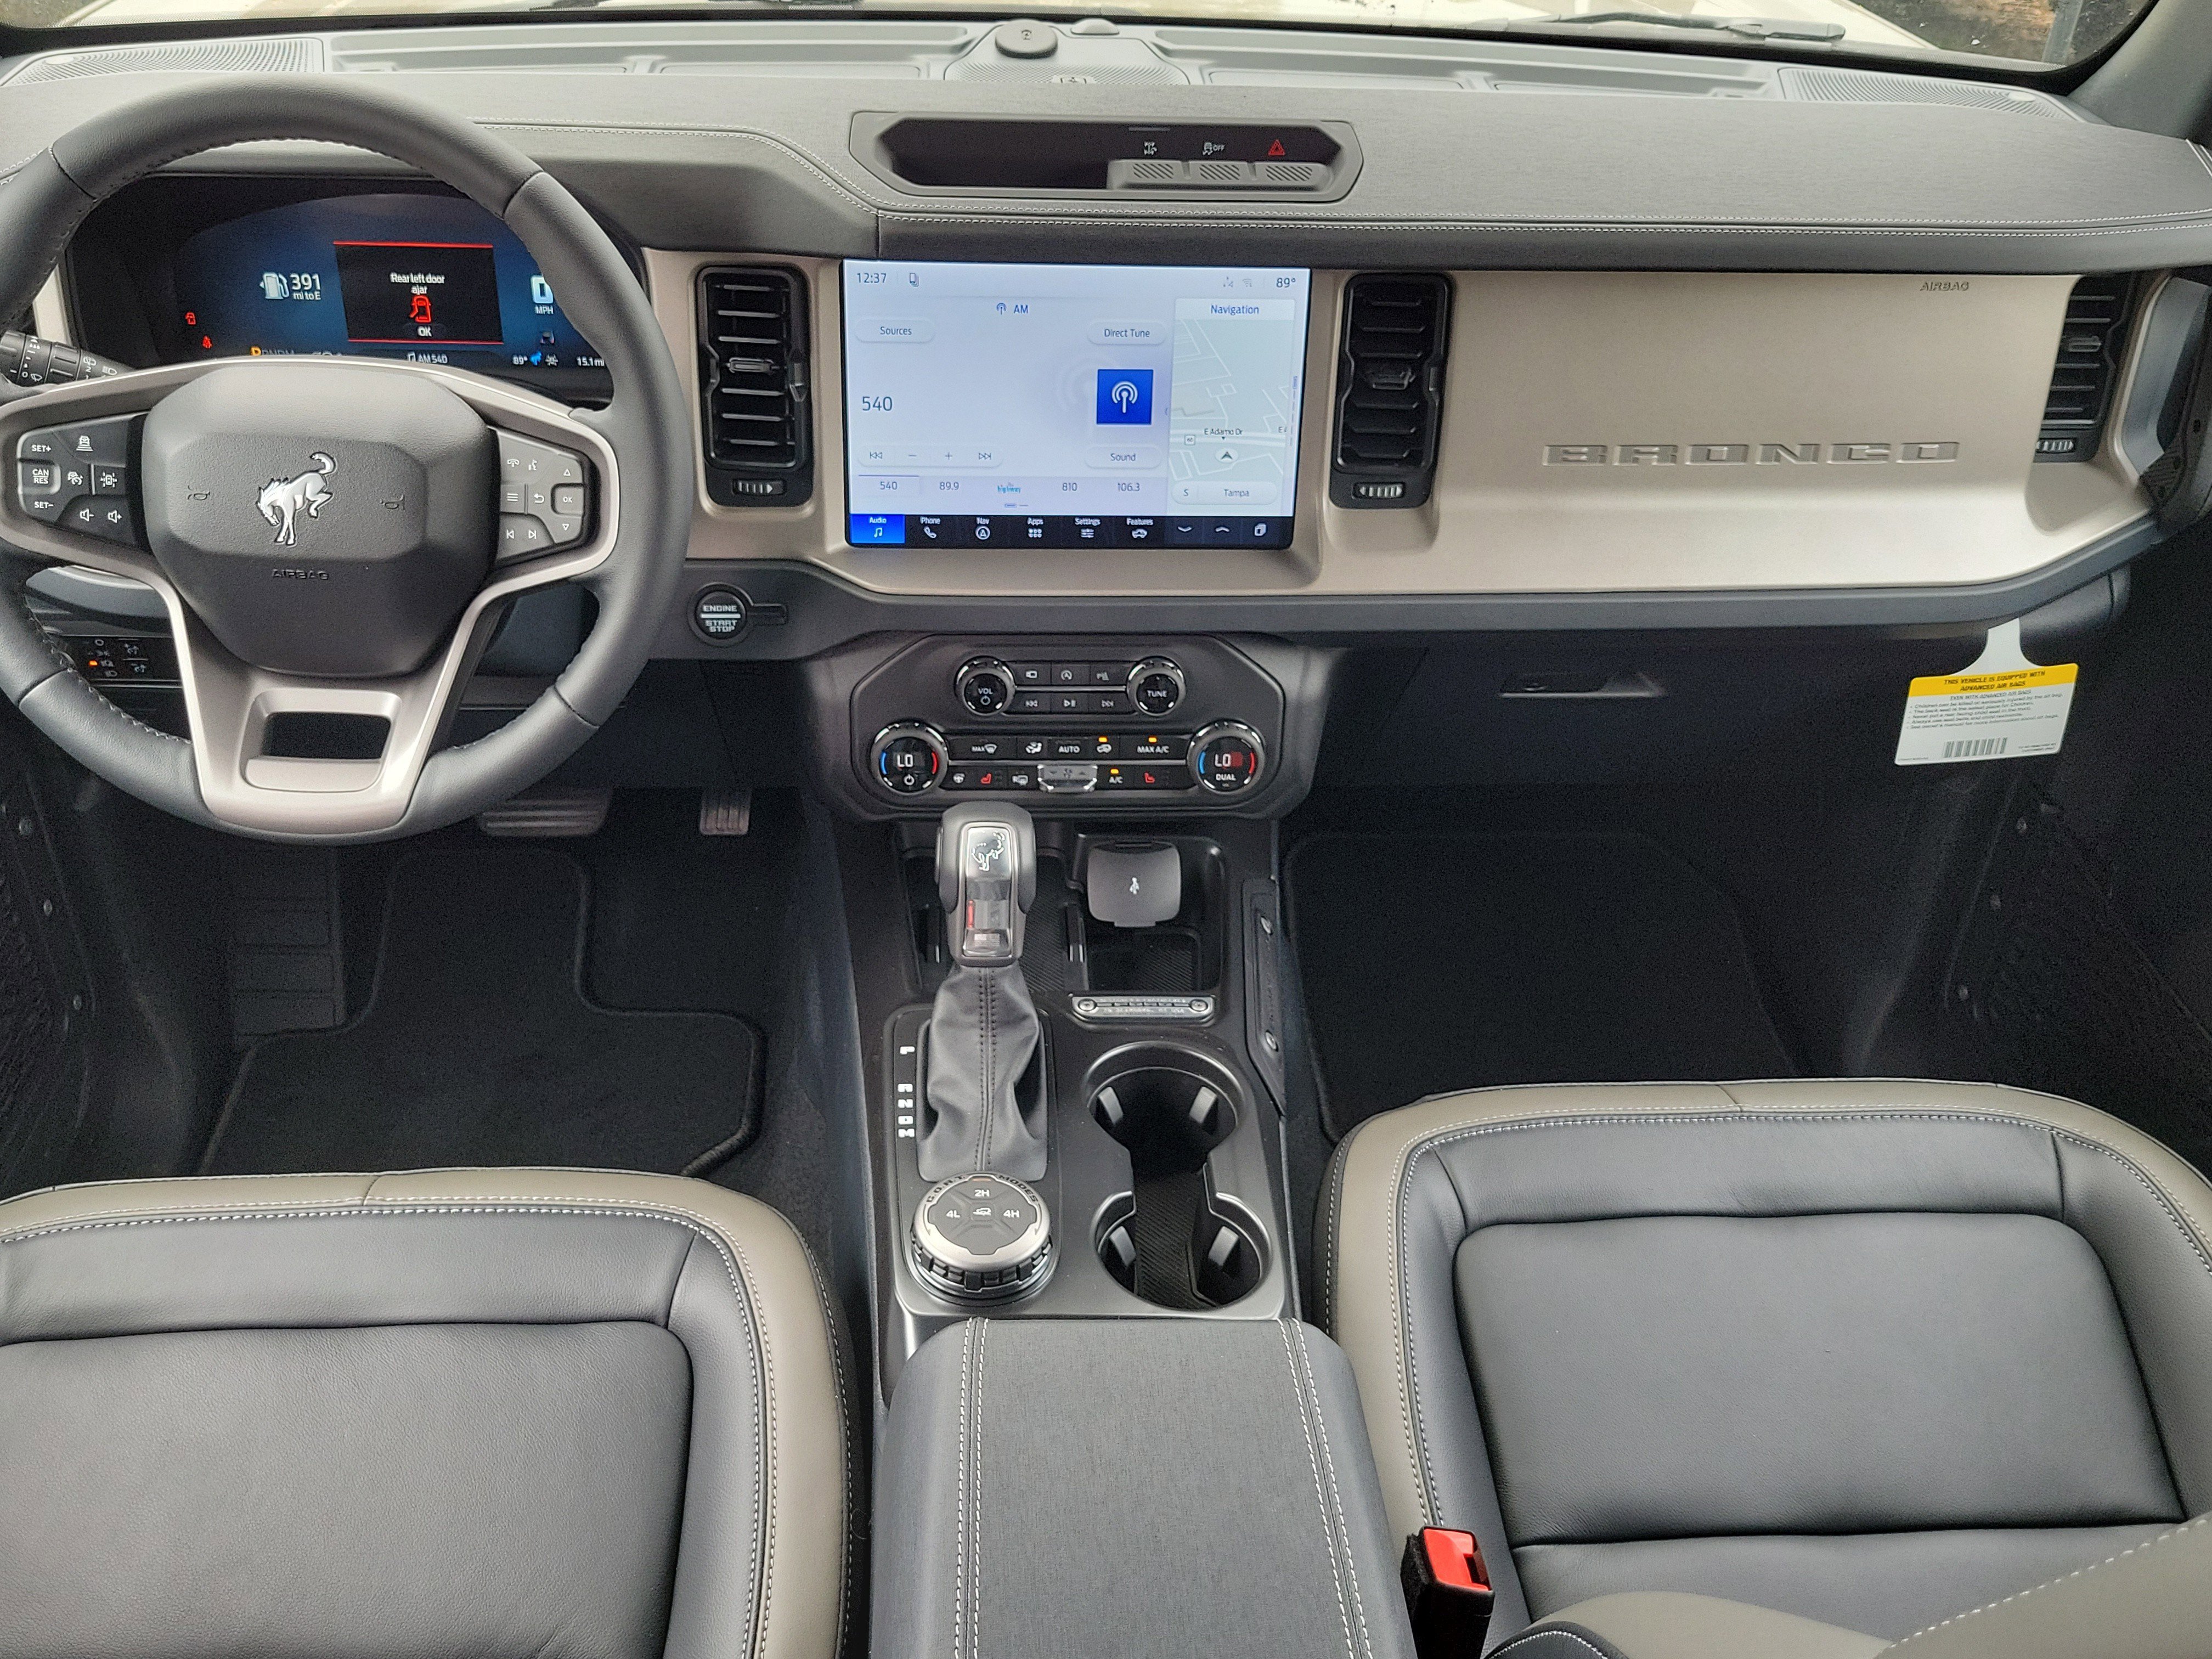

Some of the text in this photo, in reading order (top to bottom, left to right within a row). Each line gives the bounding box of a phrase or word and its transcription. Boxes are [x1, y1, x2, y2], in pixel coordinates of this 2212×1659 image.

[290, 274, 321, 290] 391
[390, 273, 445, 284] Rear left door
[856, 273, 887, 283] 12:37
[1276, 278, 1296, 288] 89°
[1920, 281, 1970, 291] AIRBAG
[411, 285, 427, 295] ajar
[535, 306, 554, 314] MPH
[1013, 305, 1029, 314] AM
[1210, 304, 1260, 315] Navigation
[417, 327, 432, 336] OK
[880, 326, 912, 336] Sources
[1104, 329, 1150, 338] Direct Tune
[417, 354, 448, 364] AM 540
[577, 357, 592, 366] 15.1
[862, 397, 893, 411] 540
[1110, 453, 1136, 461] Sound
[1542, 441, 1960, 466] BRONCO
[880, 481, 898, 490] 540
[939, 481, 959, 491] 89.9
[1062, 483, 1077, 491] 810
[1118, 482, 1140, 492] 106.3
[1224, 489, 1250, 498] Tampa
[1028, 517, 1043, 526] Apps
[1075, 518, 1101, 526] Settings
[272, 568, 329, 580] AIRBAG
[1996, 673, 2027, 681] EQUIPPED
[1960, 683, 1995, 691] ADVANCED
[1155, 746, 1170, 754] A/C
[897, 753, 913, 768] LO
[1214, 753, 1231, 768] LO
[898, 1084, 913, 1093] R
[898, 1099, 913, 1108] N
[898, 1116, 913, 1124] D
[898, 1128, 915, 1137] M
[998, 1175, 1039, 1203] MODES
[946, 1210, 961, 1218] 4L
[1003, 1210, 1020, 1218] 4H
